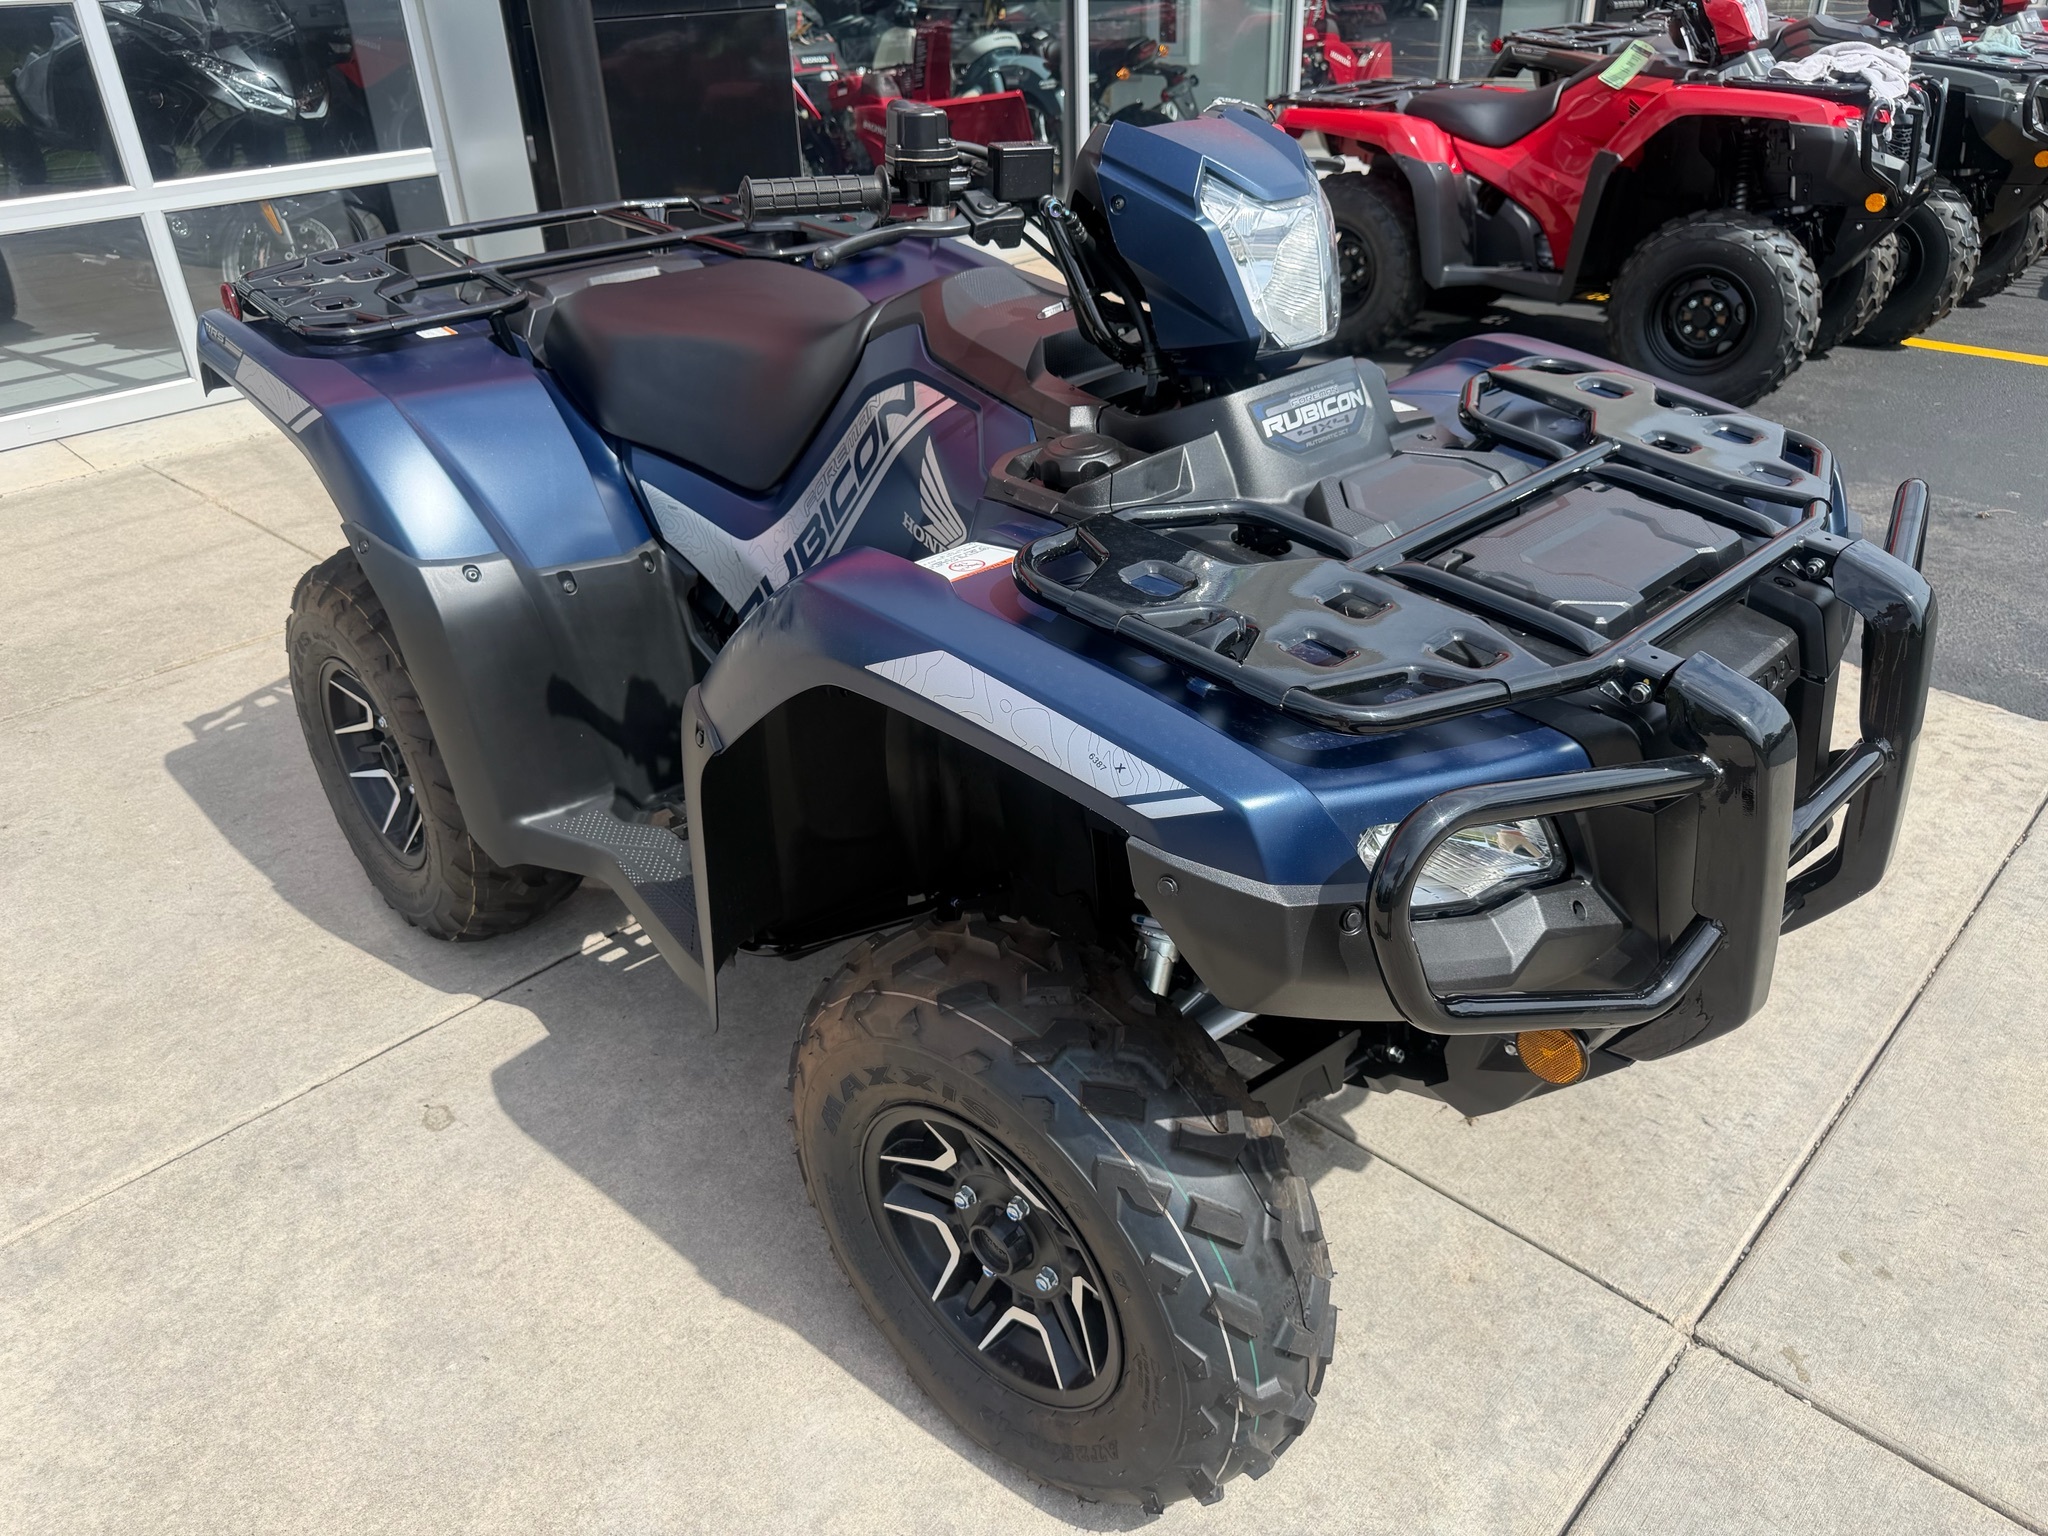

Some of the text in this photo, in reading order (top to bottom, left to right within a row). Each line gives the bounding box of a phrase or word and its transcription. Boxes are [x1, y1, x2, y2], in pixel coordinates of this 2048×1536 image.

[863, 120, 887, 138] HOND
[1290, 385, 1339, 407] FOREMAN
[1262, 388, 1365, 439] RUBICON
[1297, 414, 1350, 436] 4X4
[1306, 431, 1340, 448] AUTOMATIC
[803, 394, 881, 518] FOREMAN
[737, 379, 916, 619] UBICON
[901, 511, 947, 554] HON
[1088, 752, 1108, 771] 6387
[820, 1064, 999, 1137] MAXXIS
